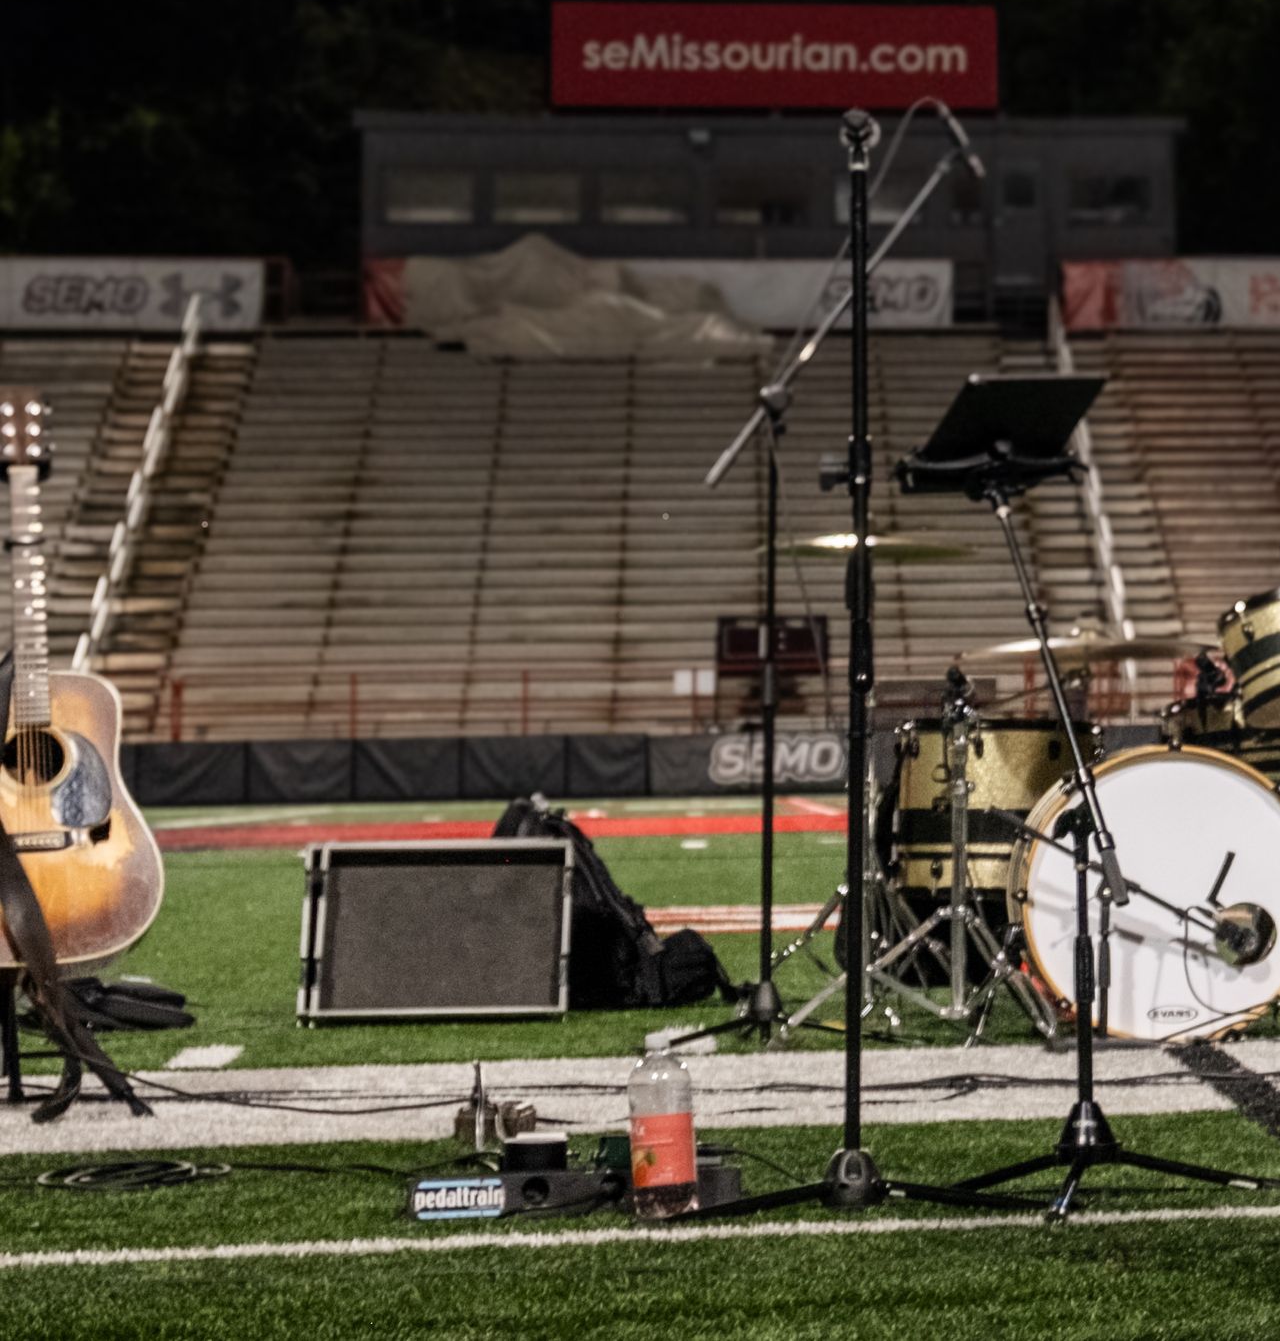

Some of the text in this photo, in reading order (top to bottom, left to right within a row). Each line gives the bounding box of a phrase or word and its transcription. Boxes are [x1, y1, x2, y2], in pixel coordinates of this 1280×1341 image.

[582, 32, 968, 74] seMissourian.com
[22, 274, 150, 316] SEMO
[821, 274, 938, 314] SMO
[413, 1185, 506, 1212] pedaltrain
